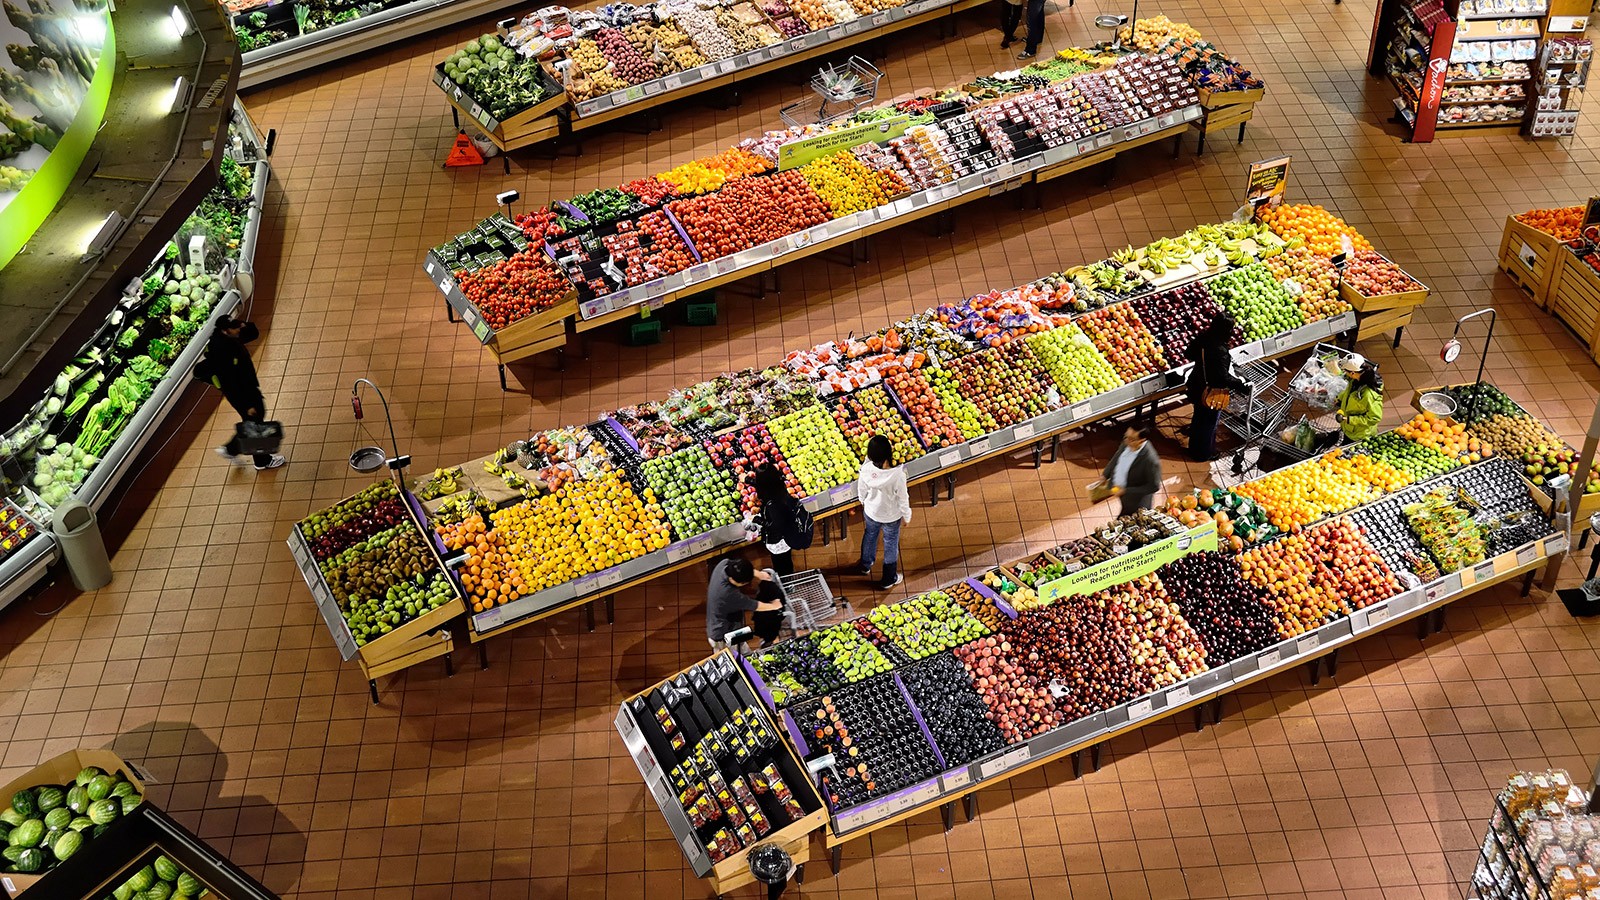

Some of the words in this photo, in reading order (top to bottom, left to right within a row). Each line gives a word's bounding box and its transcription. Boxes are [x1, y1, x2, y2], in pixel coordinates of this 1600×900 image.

[802, 138, 823, 148] Looking
[831, 131, 855, 140] nutritious
[856, 125, 877, 135] choices?
[1071, 571, 1098, 585] Looking
[1099, 566, 1109, 574] for
[1110, 553, 1143, 569] nutritious
[1145, 542, 1173, 557] choices?
[1090, 573, 1111, 584] Reach
[1112, 568, 1122, 576] for
[1123, 563, 1135, 572] the
[1136, 555, 1157, 567] Stars!
